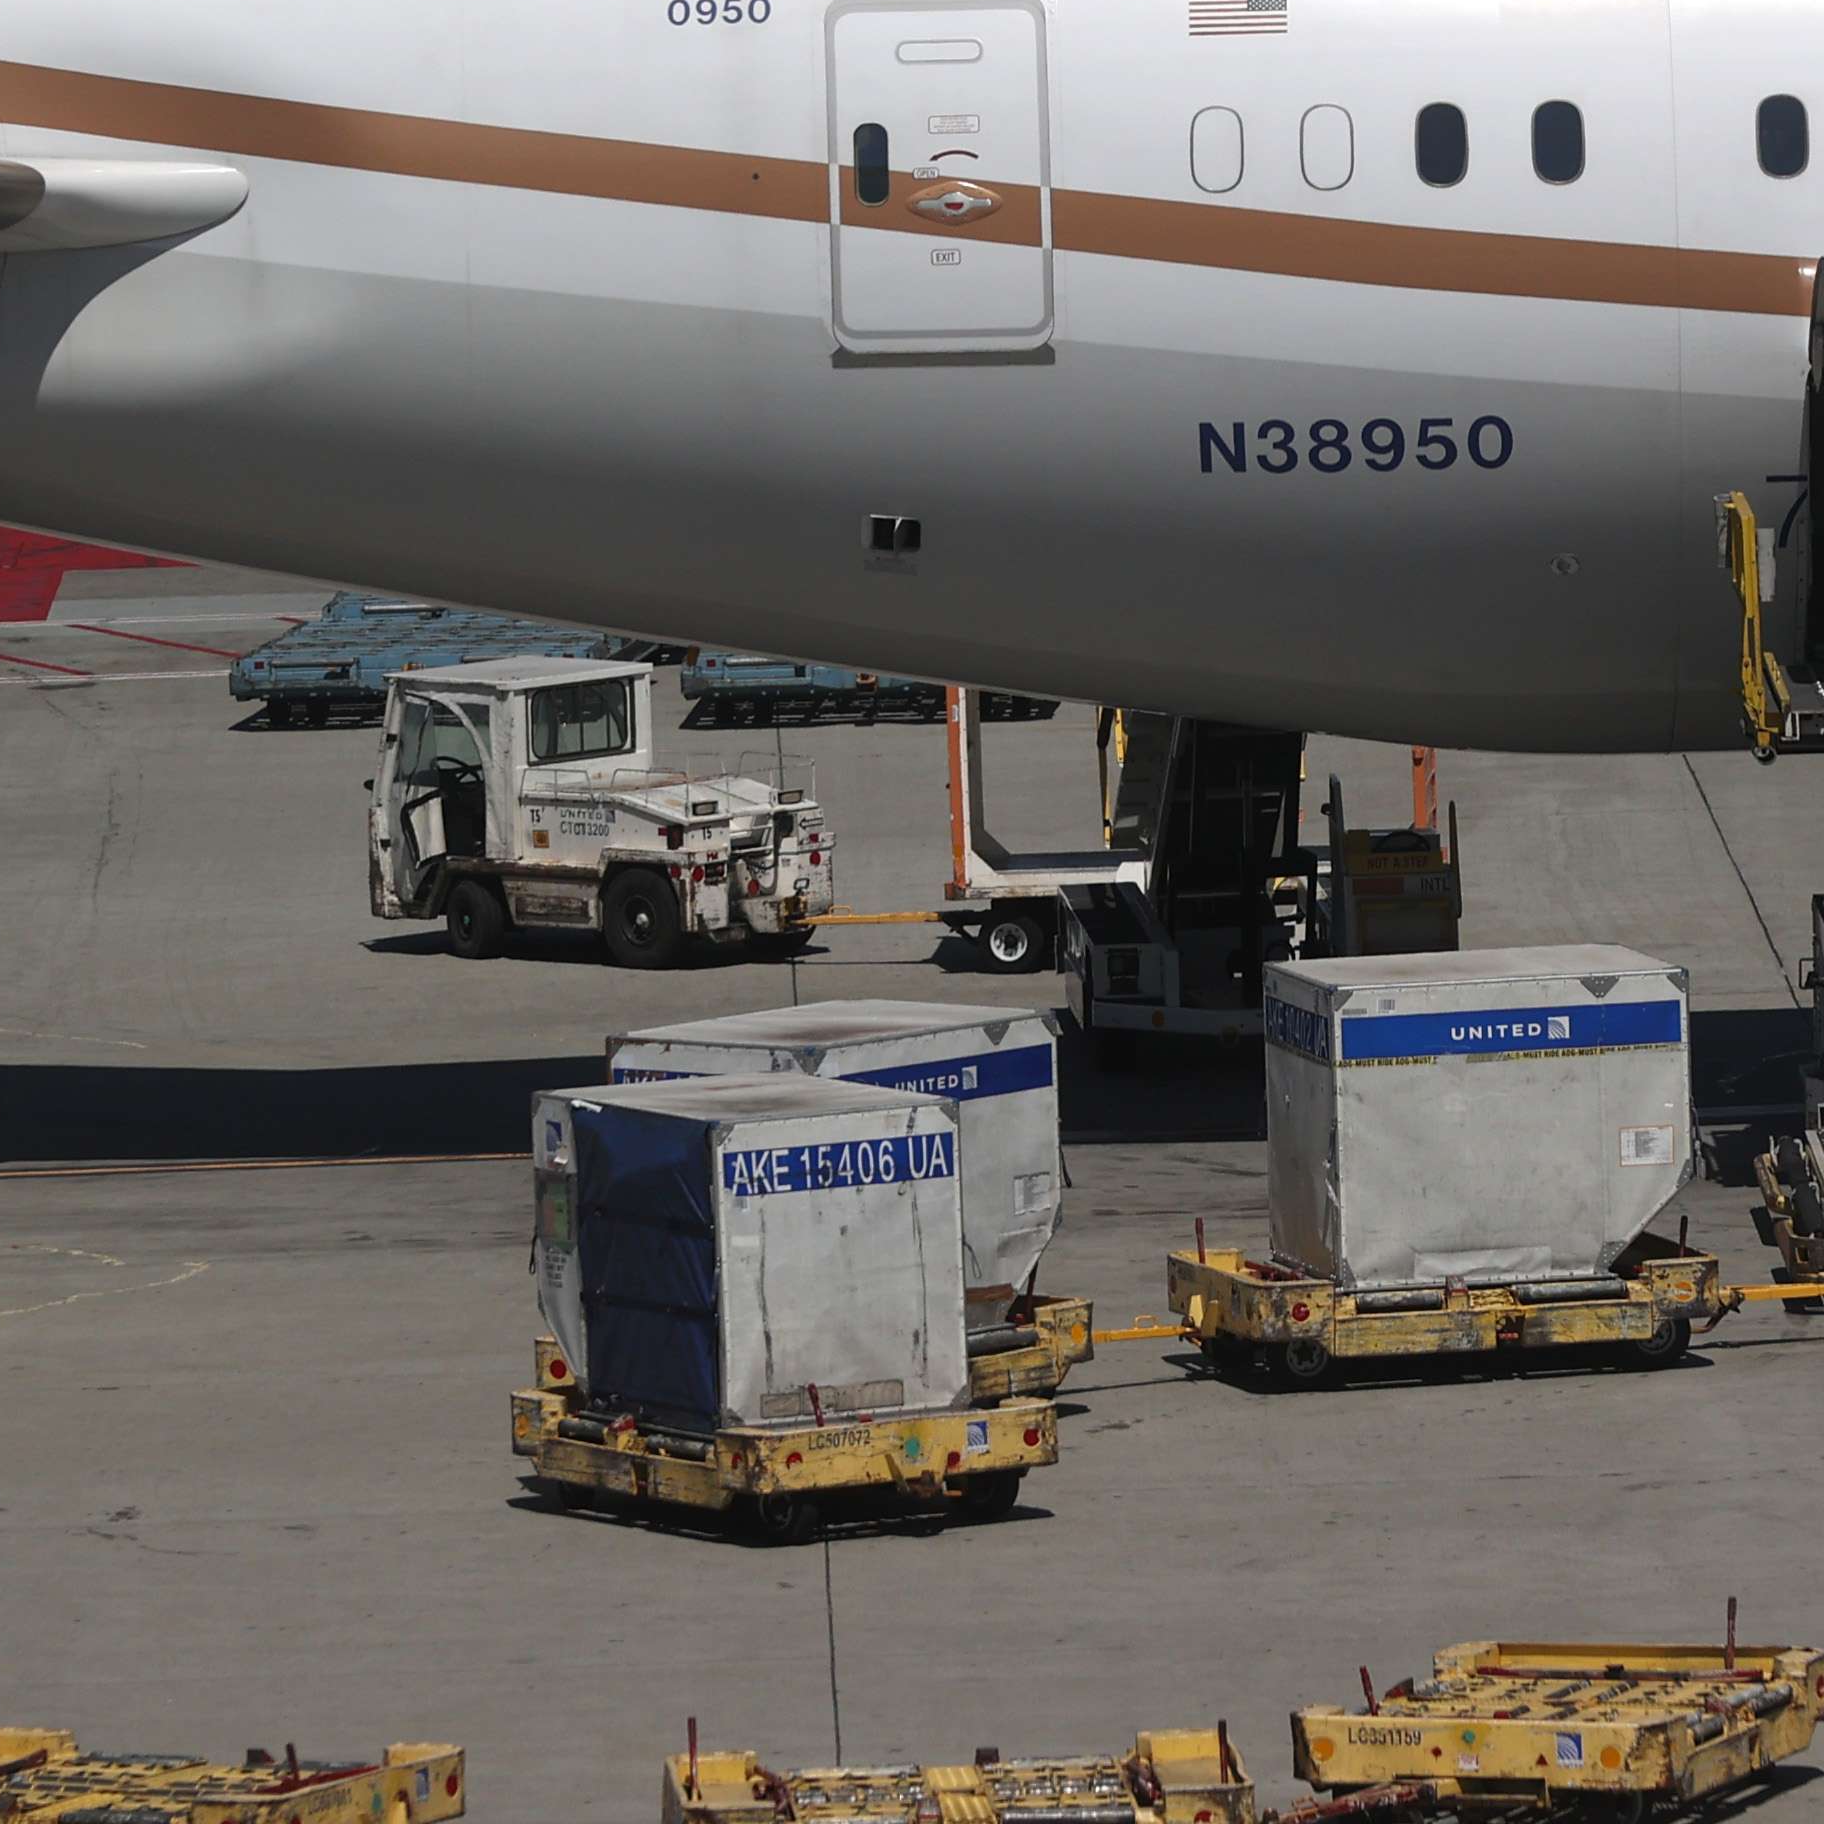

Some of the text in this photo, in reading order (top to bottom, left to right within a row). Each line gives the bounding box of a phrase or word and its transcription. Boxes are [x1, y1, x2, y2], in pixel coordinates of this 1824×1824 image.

[936, 253, 955, 262] EXIT
[1198, 415, 1514, 474] N38950
[560, 809, 603, 820] UNITED
[1420, 877, 1451, 890] INTL
[1451, 1023, 1542, 1041] UNITED
[1543, 1049, 1560, 1058] RIDE
[894, 1075, 959, 1092] UNITED
[732, 1135, 949, 1195] AKE 15406 UA
